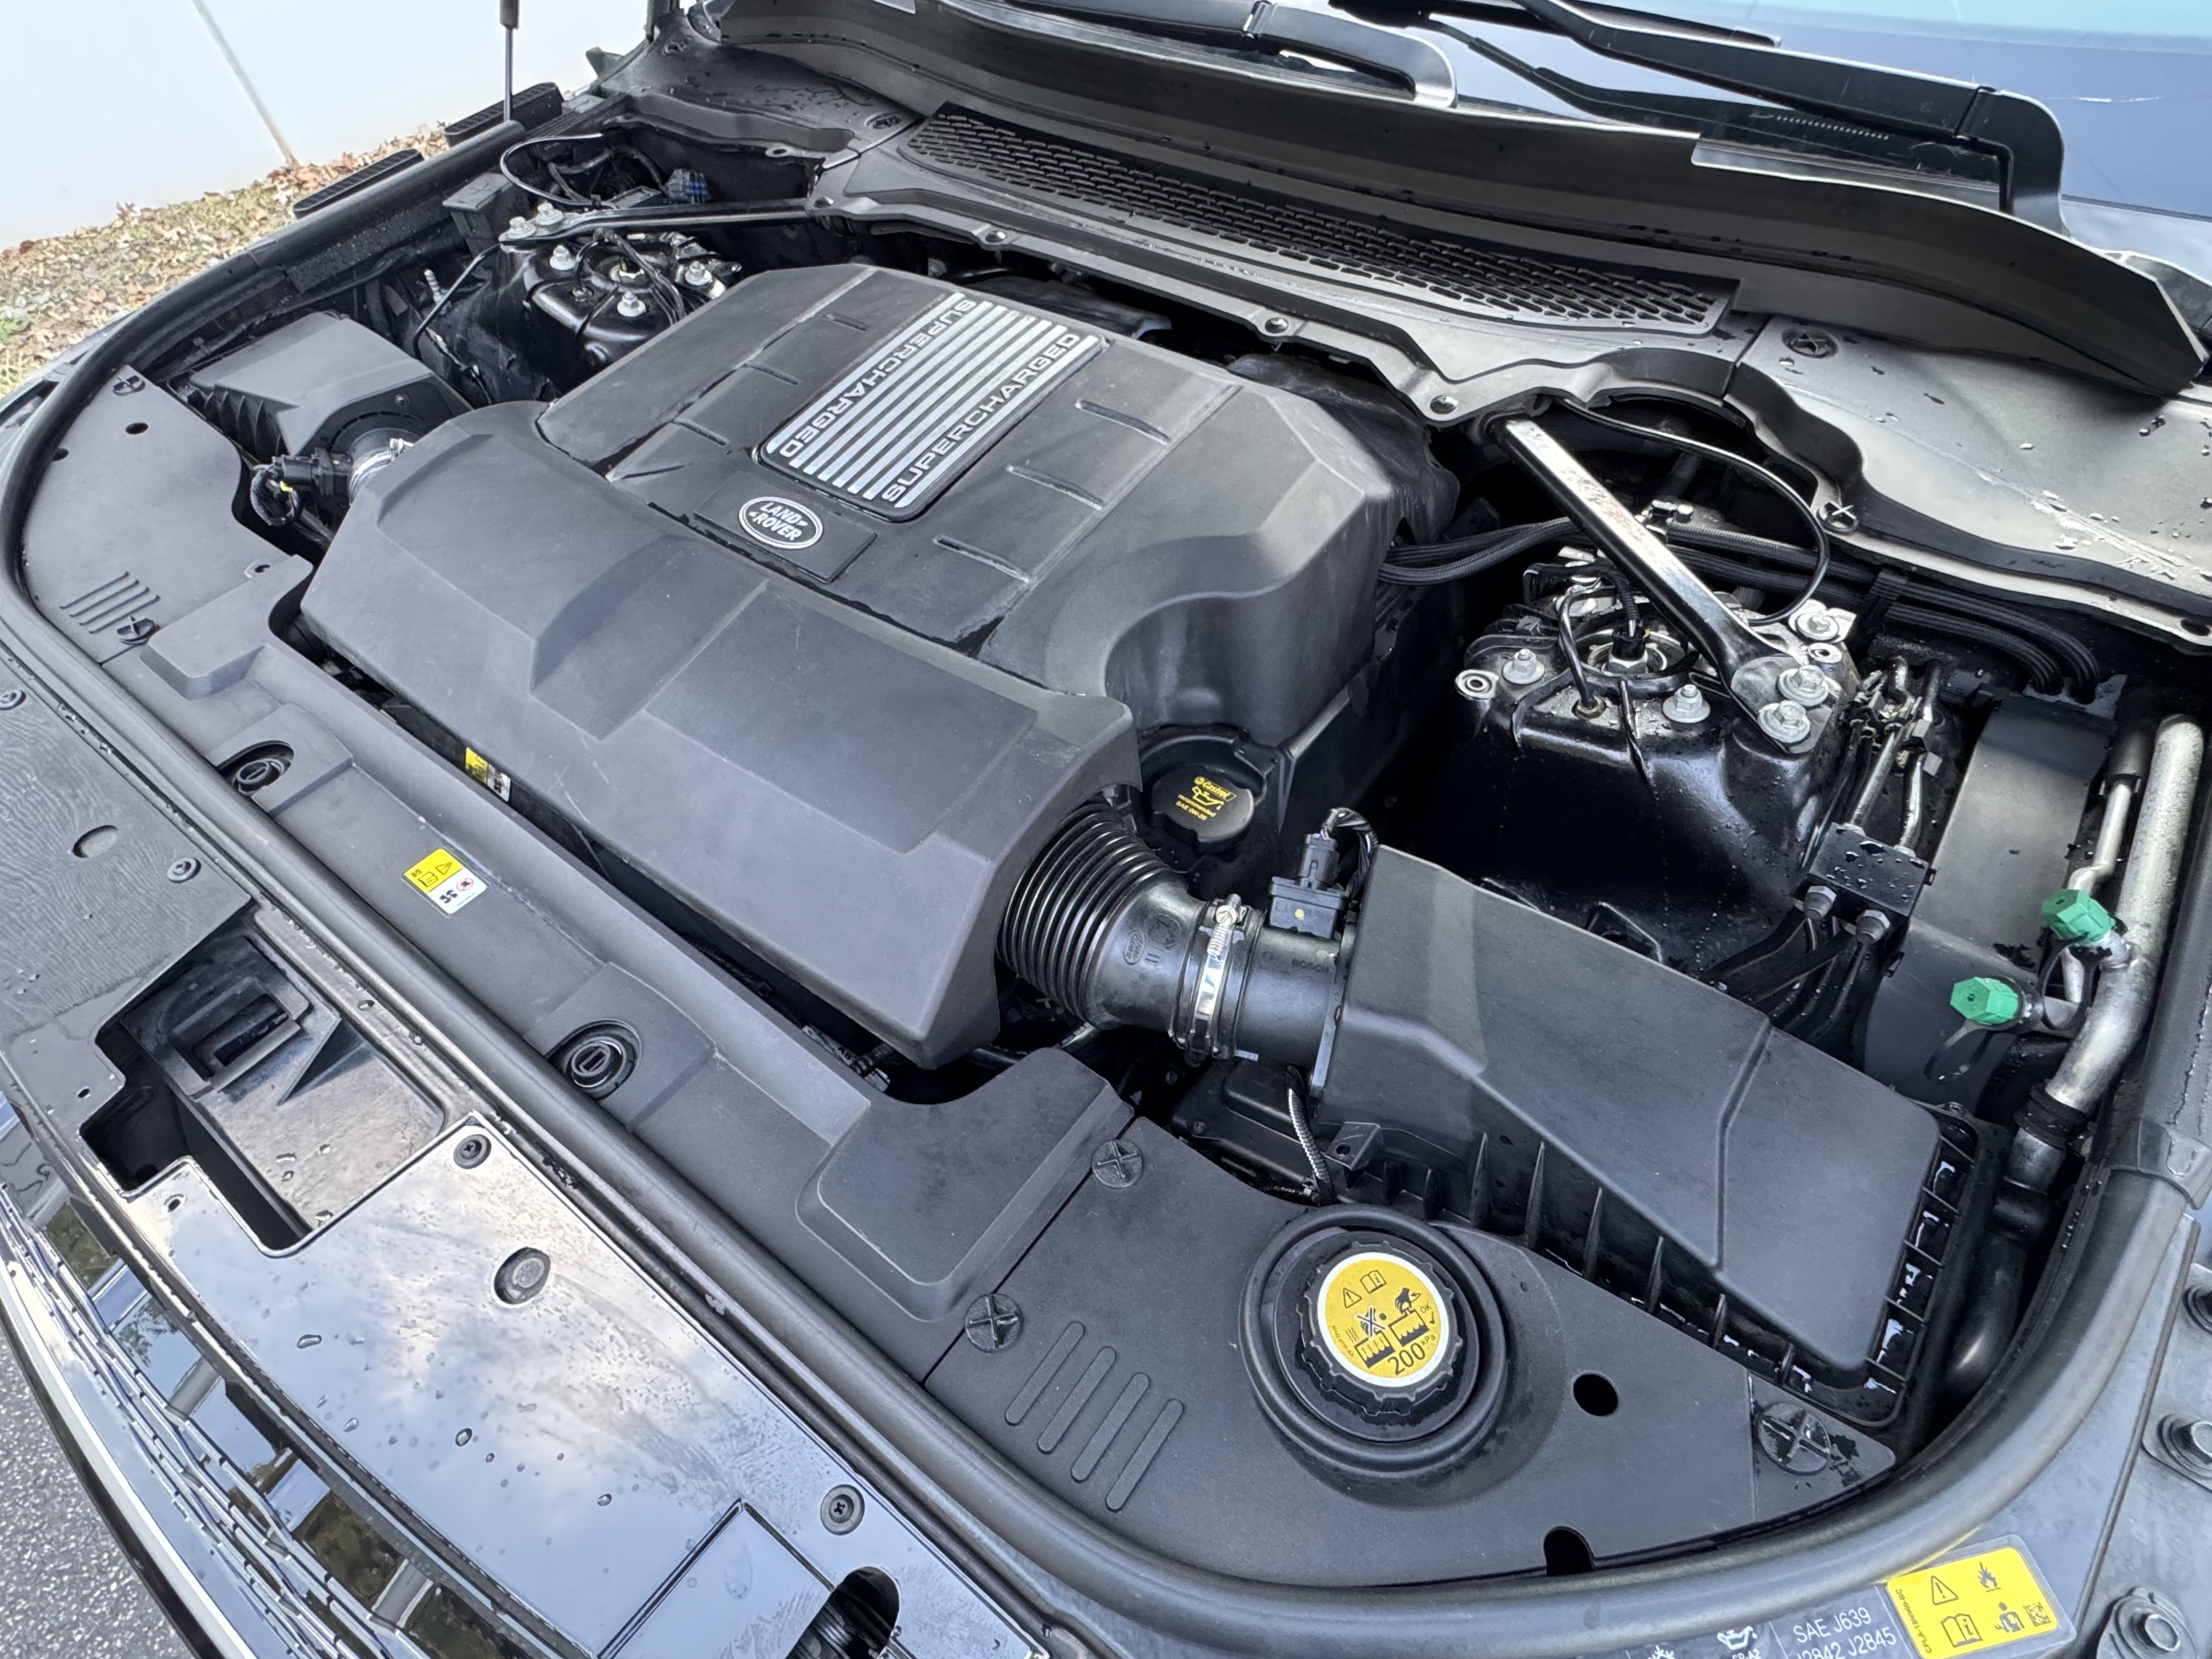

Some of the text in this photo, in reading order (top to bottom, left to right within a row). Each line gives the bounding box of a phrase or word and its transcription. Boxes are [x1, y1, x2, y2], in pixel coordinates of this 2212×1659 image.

[780, 298, 977, 458] SUPERCHARGED
[881, 333, 1081, 503] SUPERCHARGED
[752, 512, 802, 541] ROVER
[759, 502, 803, 524] LAND
[1202, 781, 1231, 799] Castrol
[1291, 958, 1329, 974] BOSCH
[1420, 1302, 1432, 1313] OK
[1387, 1334, 1436, 1375] 200 kPa
[1793, 1606, 1871, 1644] SAE J639
[1848, 1626, 1897, 1657] J2845
